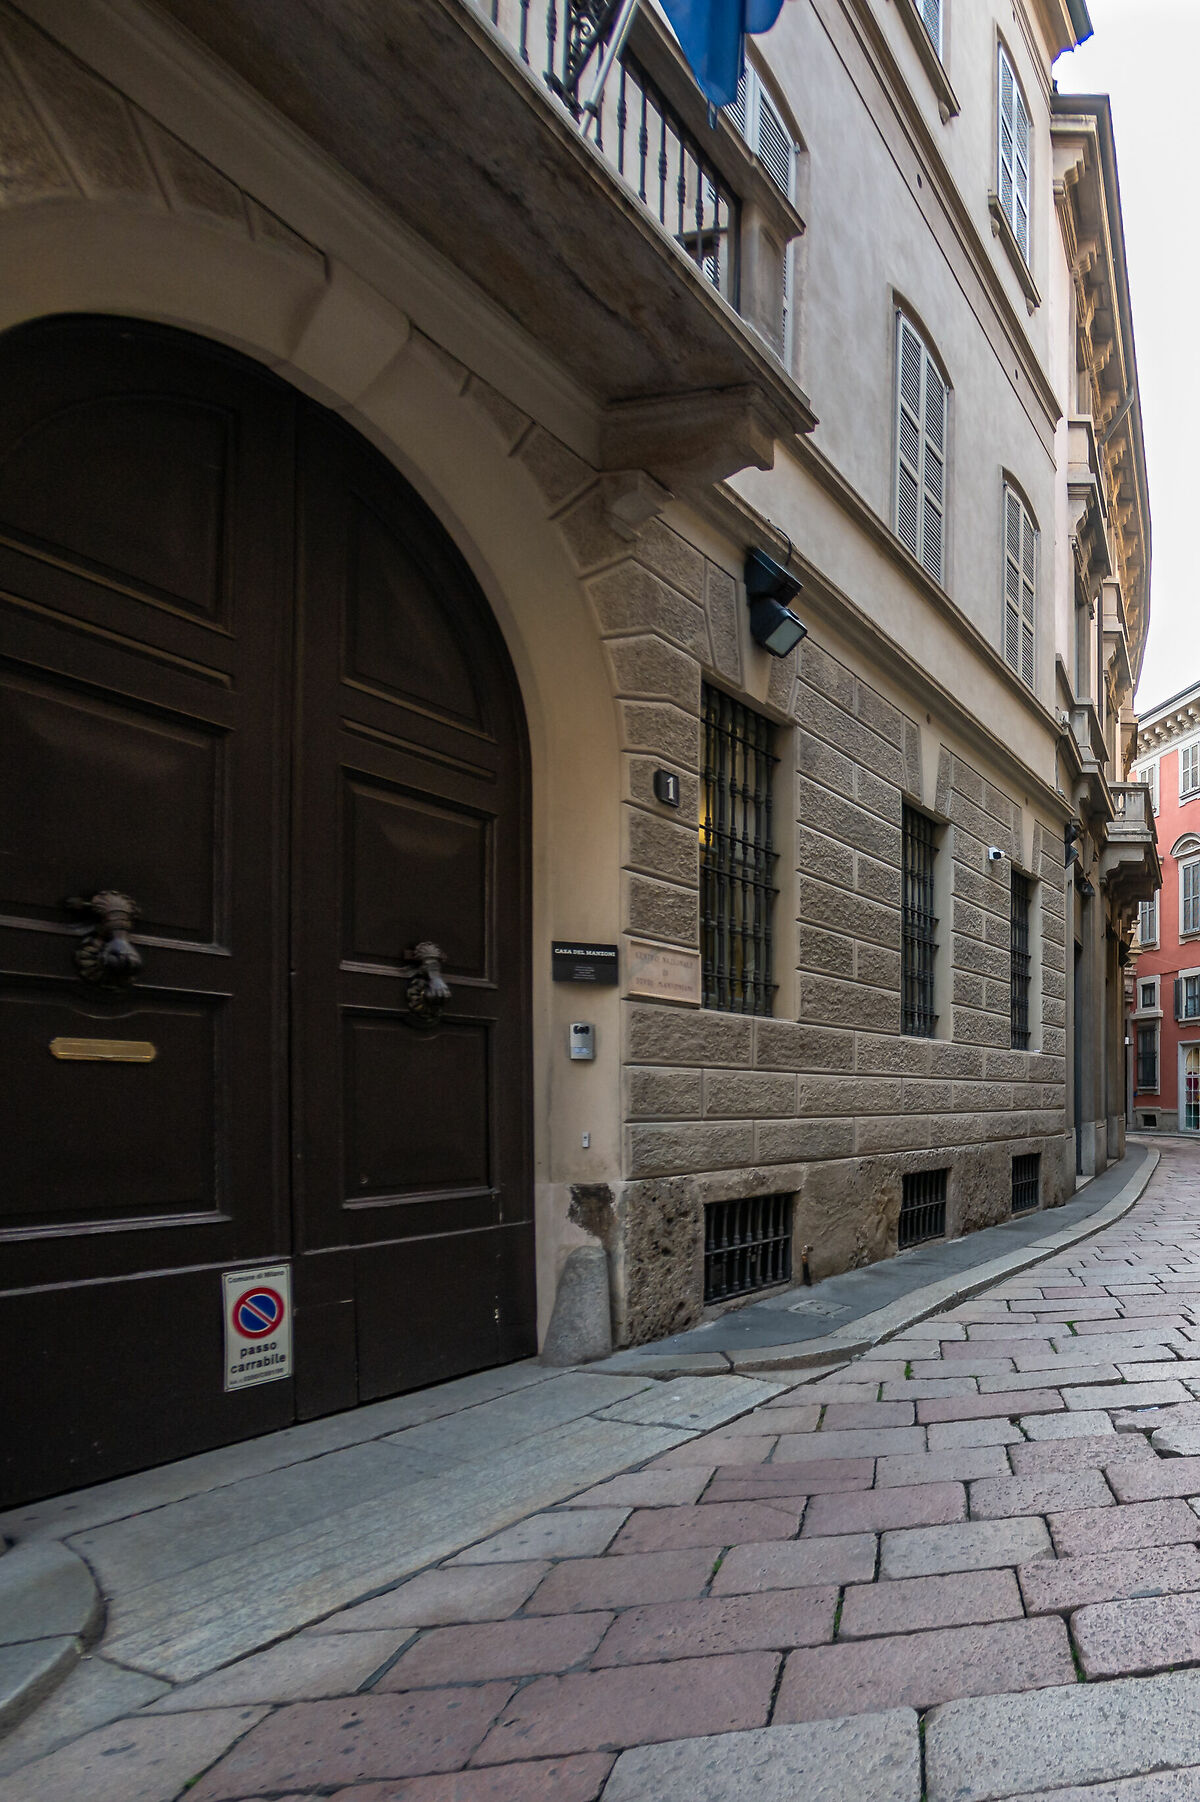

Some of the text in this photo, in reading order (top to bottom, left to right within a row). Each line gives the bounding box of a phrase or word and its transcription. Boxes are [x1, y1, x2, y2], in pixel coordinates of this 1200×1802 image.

[667, 776, 674, 800] 1
[228, 1275, 255, 1284] Comune
[263, 1270, 285, 1278] Milano
[240, 1341, 277, 1359] passo
[230, 1353, 287, 1374] carrabile
